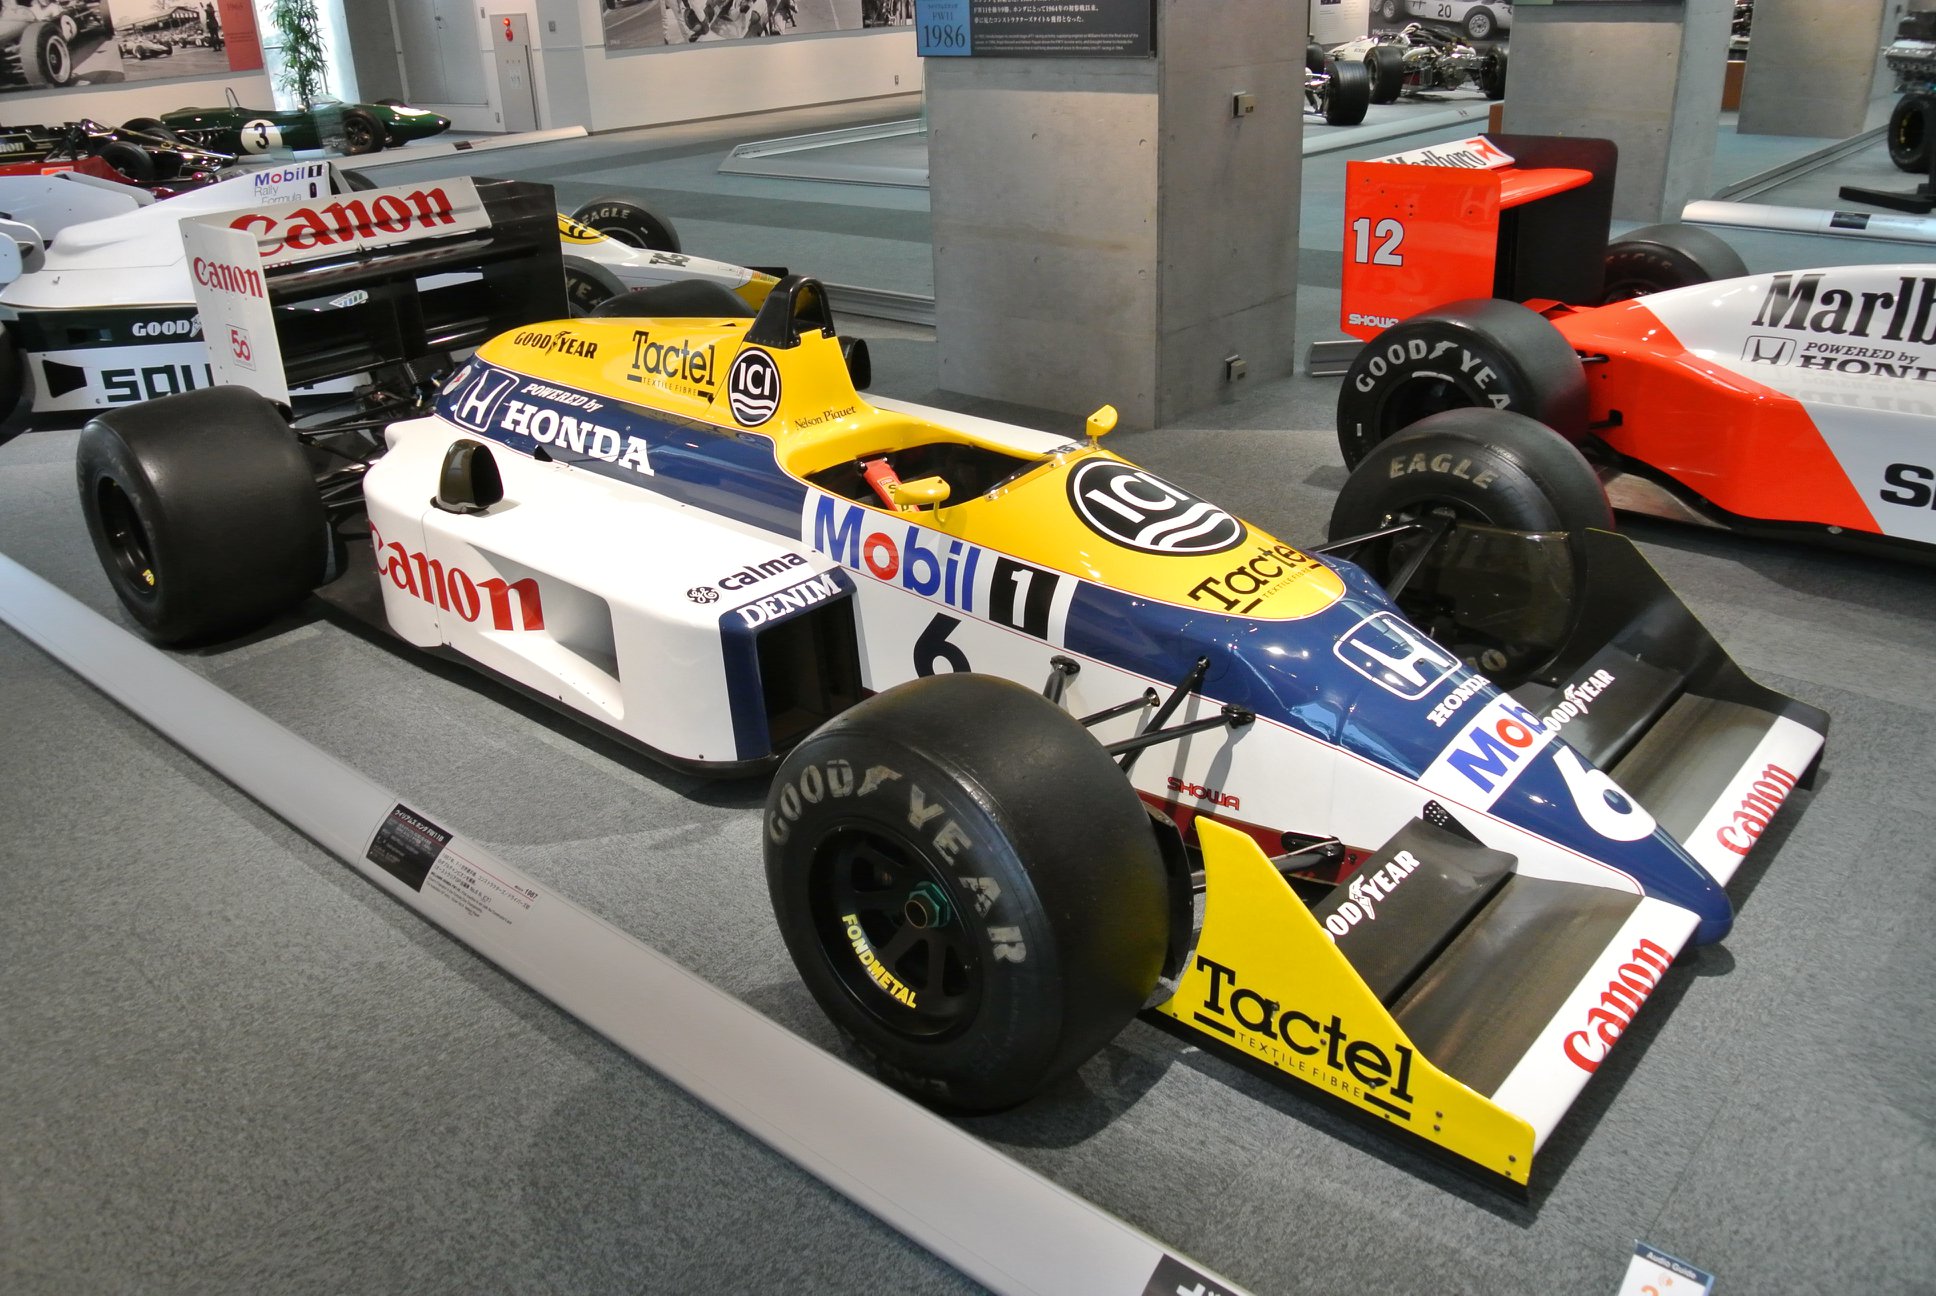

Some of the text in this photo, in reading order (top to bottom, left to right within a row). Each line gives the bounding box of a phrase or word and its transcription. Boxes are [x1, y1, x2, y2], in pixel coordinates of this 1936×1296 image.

[1438, 4, 1452, 18] 20
[924, 24, 966, 48] 1986
[254, 123, 270, 149] 3
[254, 186, 279, 196] Rally
[255, 167, 305, 187] Mobil
[230, 187, 456, 257] Canon
[581, 207, 631, 226] EAGLE
[1352, 217, 1405, 267] 12
[193, 256, 264, 298] Canon
[231, 329, 251, 361] 50
[631, 330, 716, 387] Tactel
[1803, 341, 1920, 364] POWERED by
[521, 383, 603, 413] POWERED by
[642, 377, 697, 396] TEXTILE FIBRE
[738, 362, 772, 396] ICI
[501, 401, 655, 477] HONDA
[794, 405, 856, 431] Nelson Piquet
[1390, 453, 1500, 489] EAGLE
[1880, 463, 1936, 511] S
[1085, 472, 1190, 524] ICI
[718, 552, 809, 591] calma
[815, 494, 982, 613] Mobil
[1187, 539, 1312, 612] Tacte
[736, 573, 842, 629] DENIM
[913, 613, 972, 677] 6
[1427, 674, 1491, 728] HONDA
[1167, 776, 1240, 811] SHOWA
[1552, 745, 1657, 842] 6
[1715, 762, 1799, 857] Canon
[842, 913, 917, 1009] FONDMETAL
[1563, 937, 1674, 1074] Canon
[1196, 955, 1414, 1104] Tactel
[1238, 1030, 1362, 1099] TEXTILE FIBRE
[1646, 1252, 1697, 1280] Audio Guide
